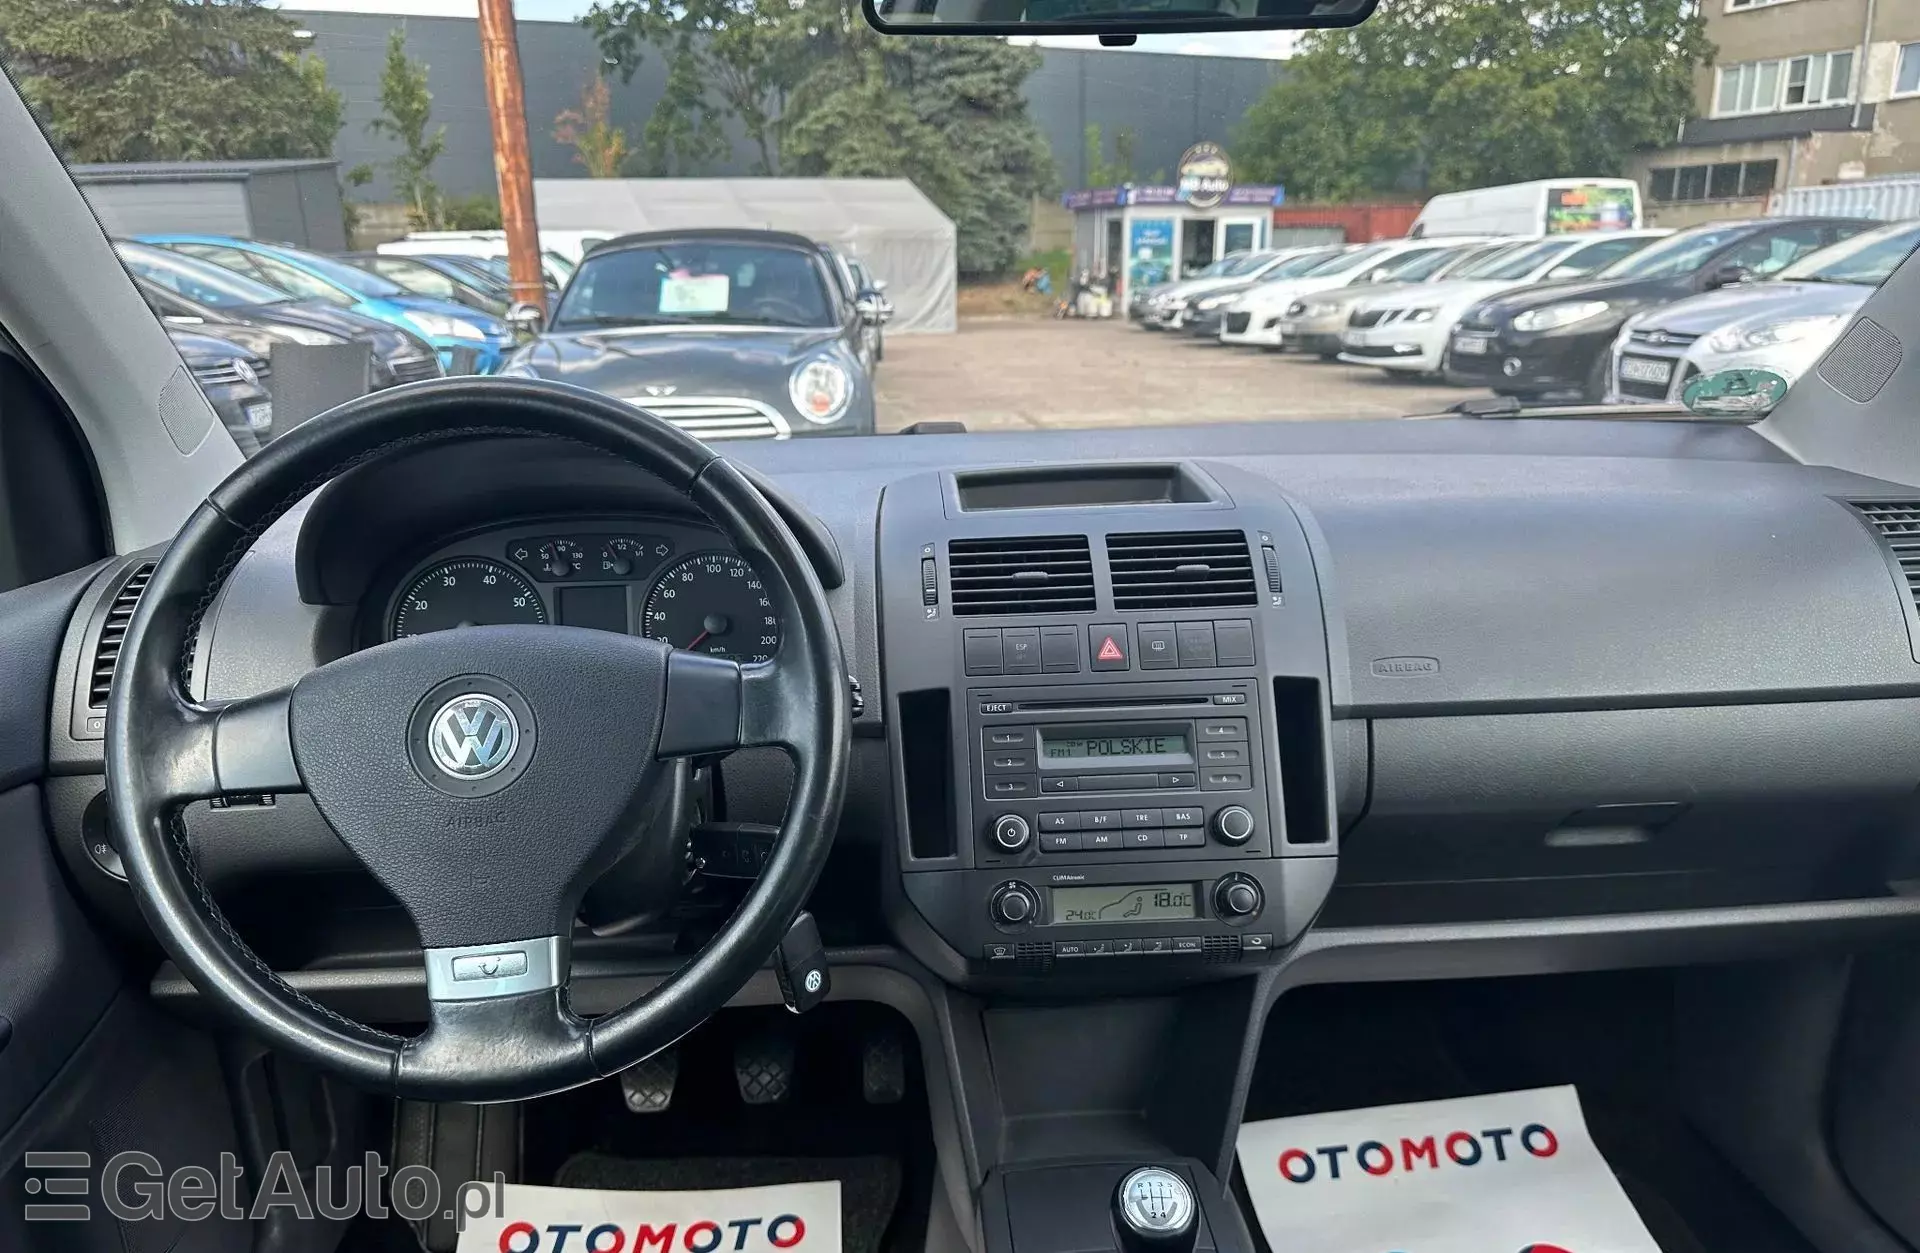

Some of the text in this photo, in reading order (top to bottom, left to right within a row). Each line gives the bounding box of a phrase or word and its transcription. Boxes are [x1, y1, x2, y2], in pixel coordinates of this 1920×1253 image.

[706, 564, 721, 573] 100
[730, 568, 744, 577] 120
[443, 576, 455, 586] 30
[483, 575, 496, 585] 40
[682, 573, 694, 581] 80
[747, 581, 762, 589] 140
[663, 589, 676, 598] 60
[415, 600, 428, 610] 20
[513, 597, 526, 607] 50
[653, 612, 666, 621] 40
[760, 636, 777, 645] 200
[1015, 643, 1028, 651] ESP
[1378, 662, 1433, 673] AIRBAG
[986, 704, 1007, 712] EJECT
[1086, 738, 1167, 757] POLSKIE
[1278, 1122, 1559, 1184] OTOMOTO
[499, 1214, 805, 1253] OTOMOTO
